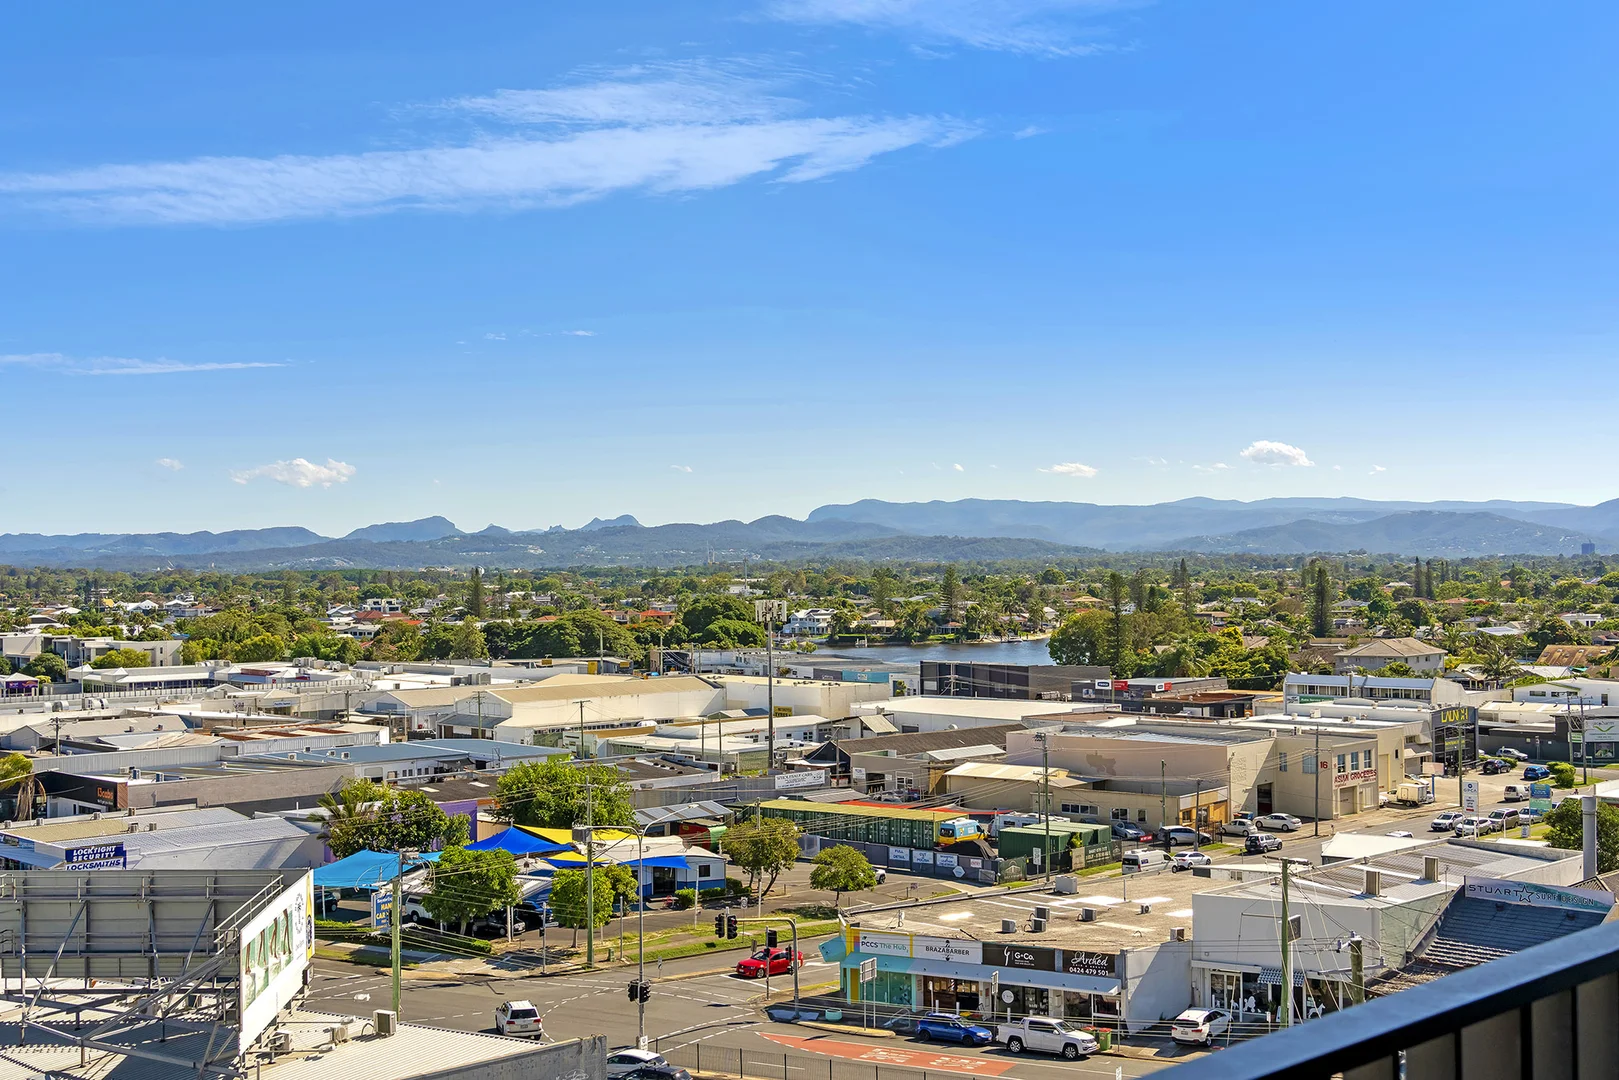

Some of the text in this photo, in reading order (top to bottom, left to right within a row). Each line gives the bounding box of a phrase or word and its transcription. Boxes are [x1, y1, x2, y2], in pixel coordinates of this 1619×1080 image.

[1320, 761, 1328, 769] 16
[1334, 769, 1377, 783] ASIAN GROCERIES
[73, 852, 115, 861] SECURITY
[66, 860, 121, 870] LOCKSMITHS
[1468, 884, 1595, 906] STUART SURF DESIGN
[861, 941, 879, 949] PCCS
[893, 943, 907, 951] Hub
[925, 946, 970, 956] BRAZABARBER
[1071, 951, 1109, 966] Arched
